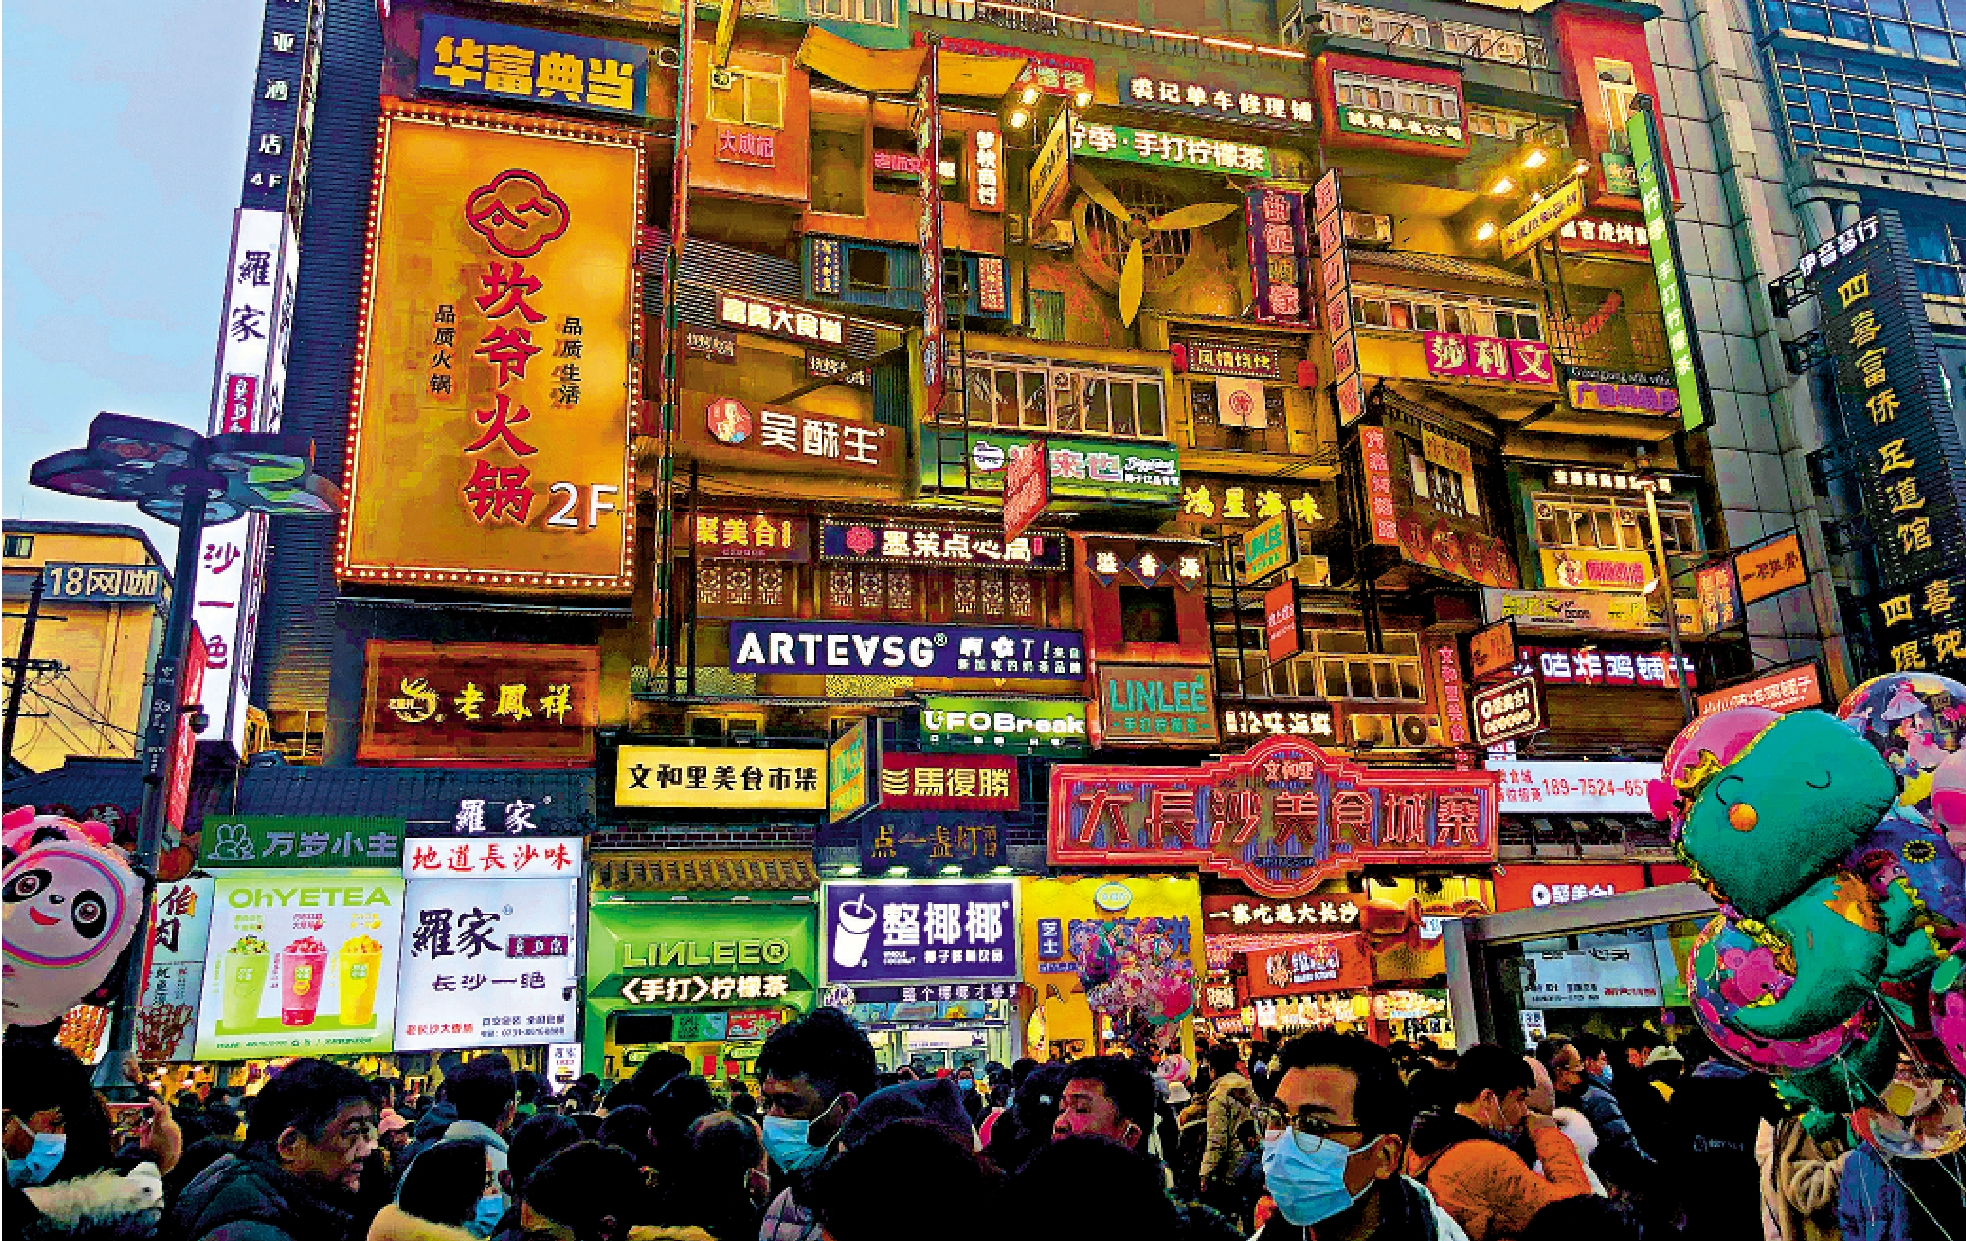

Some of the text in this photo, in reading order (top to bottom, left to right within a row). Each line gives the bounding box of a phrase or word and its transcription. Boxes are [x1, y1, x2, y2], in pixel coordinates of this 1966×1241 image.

[434, 35, 634, 110] 华富典当
[230, 250, 272, 343] 羅家
[430, 304, 456, 396] 品质火锅
[557, 316, 583, 406] 品质生活
[463, 262, 547, 523] 坎爷火锅
[1838, 271, 1935, 554] 四喜富侨足道馆
[547, 481, 619, 528] 2F
[49, 567, 158, 596] 18网咖
[1109, 679, 1208, 713] LINLEE
[626, 763, 818, 791] 文和里美食市集
[455, 799, 538, 834] 羅家
[262, 831, 398, 858] 万岁小主
[412, 843, 573, 873] 地道長沙味
[228, 886, 391, 909] OhYETEA
[411, 906, 503, 960] 羅家
[882, 901, 1003, 946] 整椰椰
[432, 971, 546, 991] 长沙一绝
